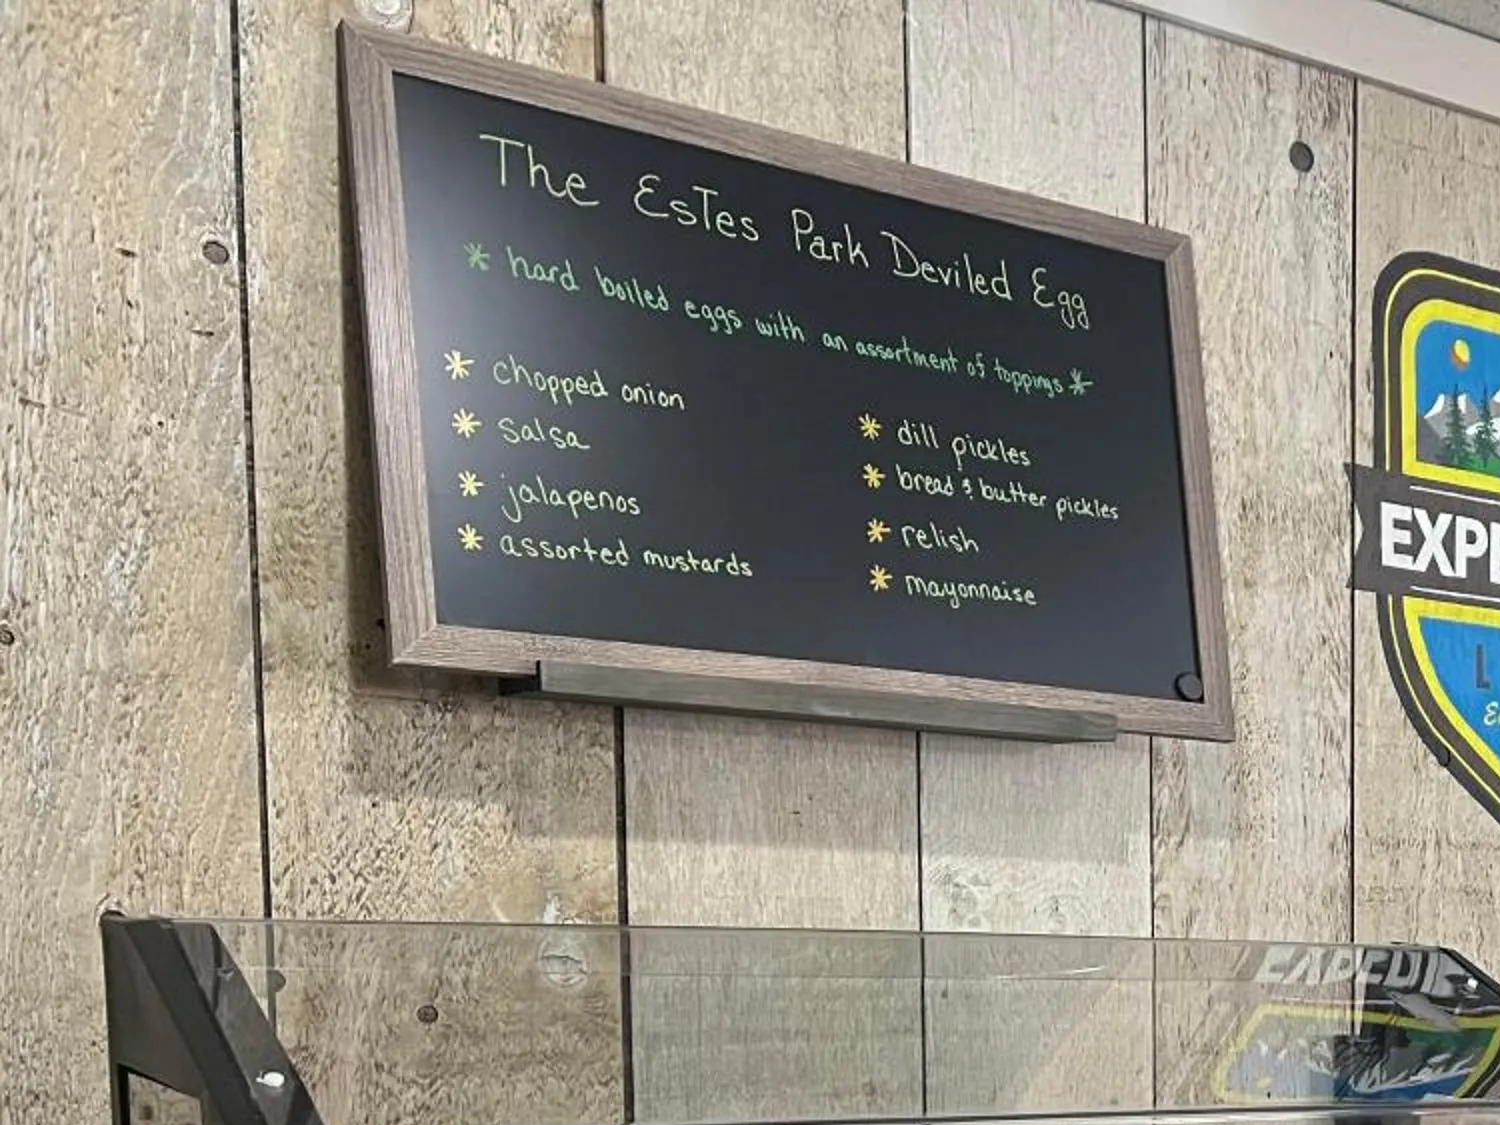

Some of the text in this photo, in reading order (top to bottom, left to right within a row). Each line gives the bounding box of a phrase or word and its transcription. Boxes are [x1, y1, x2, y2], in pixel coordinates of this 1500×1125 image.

[480, 134, 599, 205] The
[792, 209, 869, 267] Park
[881, 231, 1012, 300] Deviled
[1033, 267, 1089, 329] Egg
[507, 247, 1063, 398] hard boiled eggs with an assortment of toppings
[492, 354, 685, 410] chopped onion
[897, 419, 1031, 471] dill pickles
[500, 473, 641, 523] jalapenos
[895, 463, 955, 496] bread
[978, 477, 1047, 507] butter
[1055, 496, 1119, 521] pickles
[500, 534, 753, 577] assorted mustards
[901, 521, 979, 553] relish
